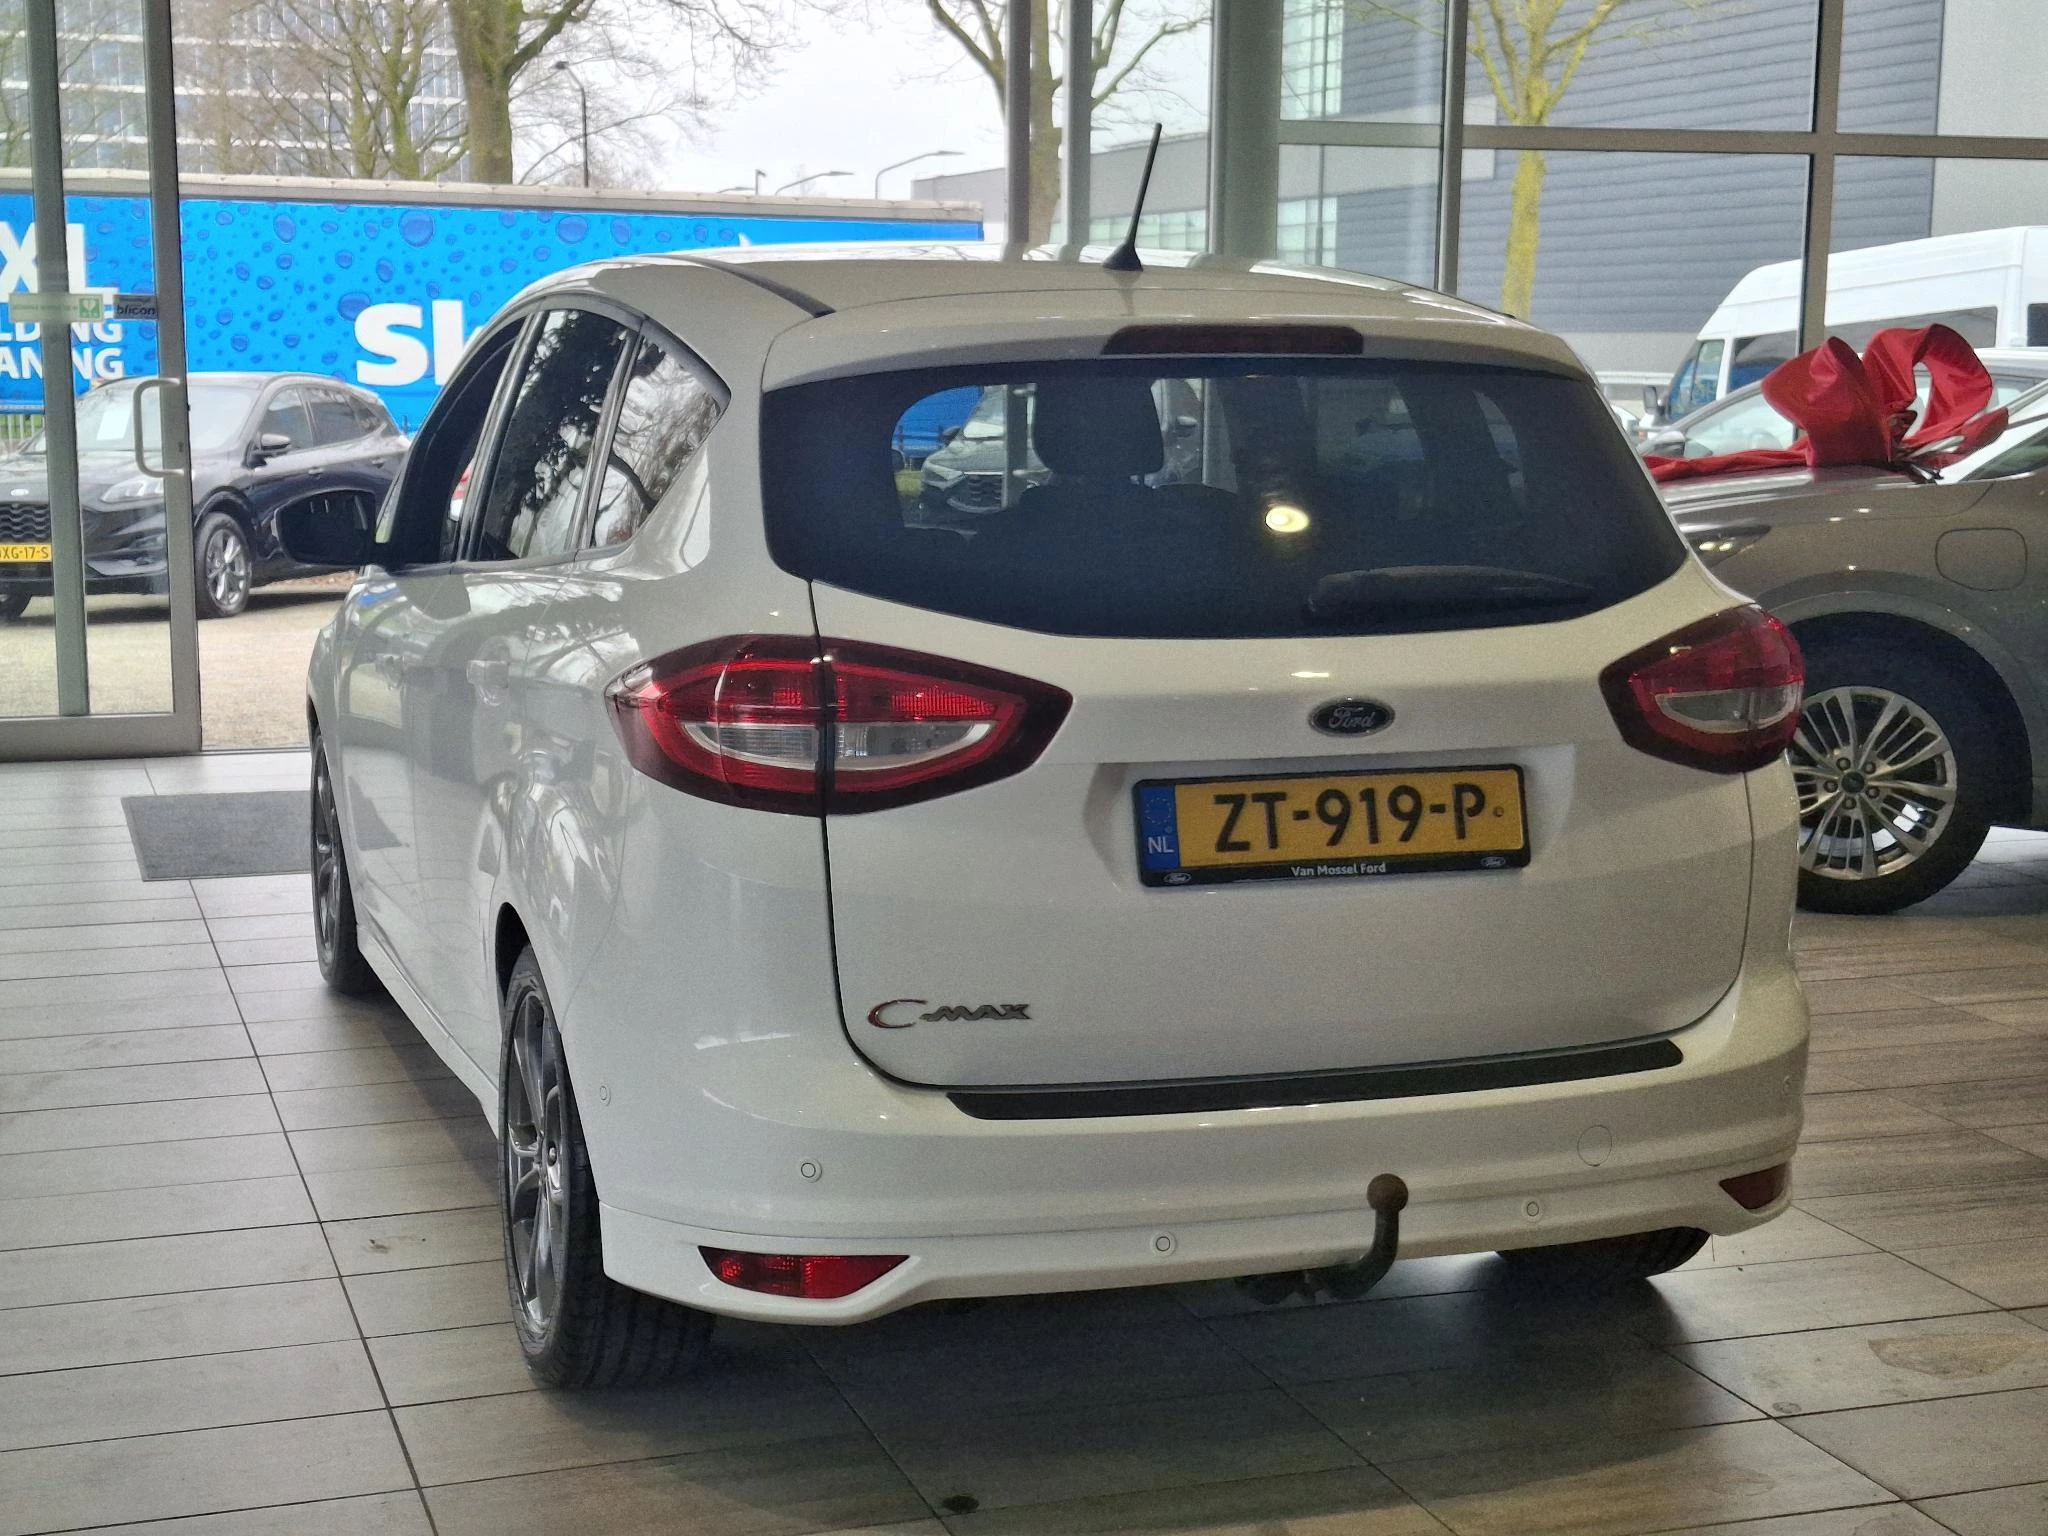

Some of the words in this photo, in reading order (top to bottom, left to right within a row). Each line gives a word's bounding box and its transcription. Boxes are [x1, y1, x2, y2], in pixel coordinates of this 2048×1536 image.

[0, 222, 119, 305] XL
[0, 346, 124, 380] ANNG
[0, 546, 49, 559] XG-17-S
[1328, 706, 1376, 729] Ford
[1213, 782, 1486, 853] ZT-919-P
[1147, 836, 1175, 854] NL
[1291, 866, 1315, 877] Van
[1317, 862, 1358, 875] Mossel
[1361, 861, 1386, 874] Ford
